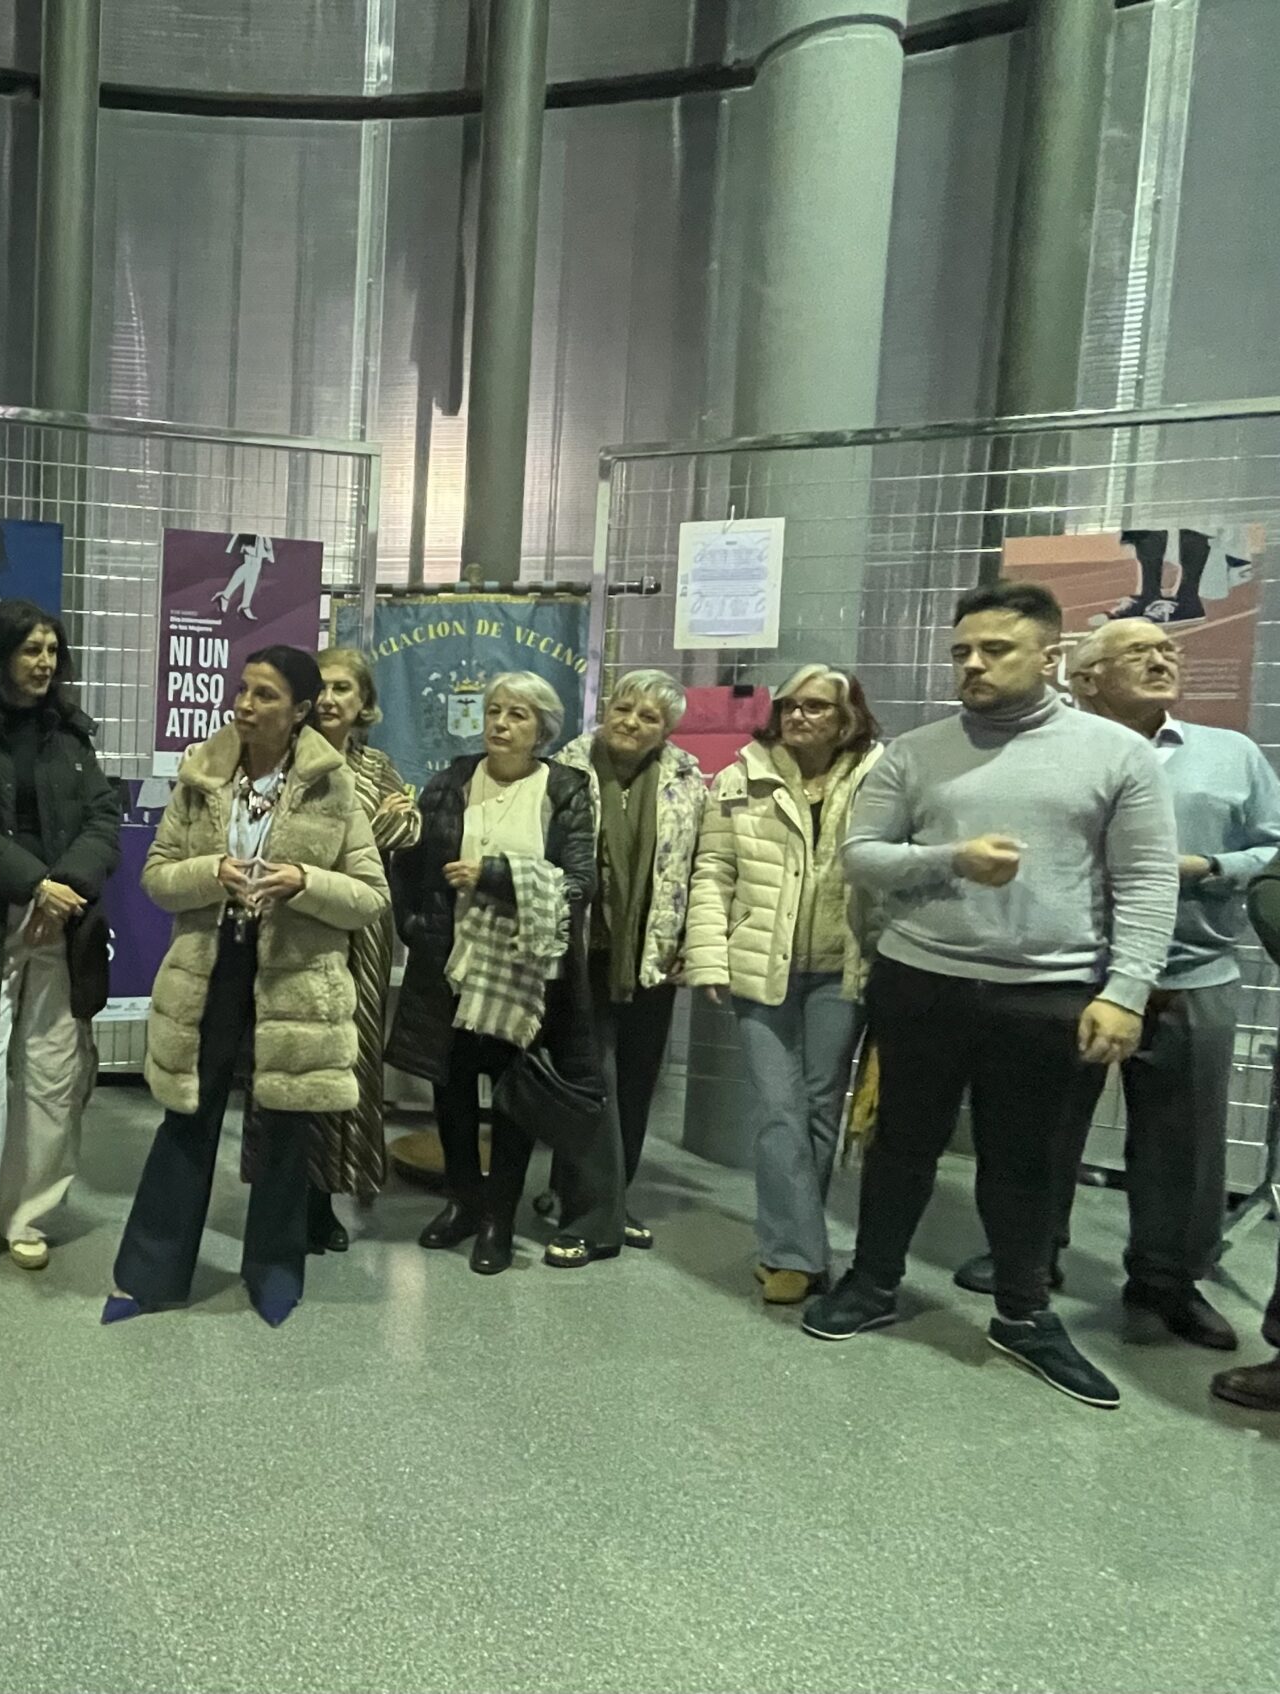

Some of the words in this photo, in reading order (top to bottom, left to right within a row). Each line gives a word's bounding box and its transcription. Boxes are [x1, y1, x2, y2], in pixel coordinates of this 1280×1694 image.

[169, 635, 193, 667] NI
[198, 637, 229, 669] UN
[476, 619, 504, 638] DE
[515, 626, 588, 673] VECINO
[167, 671, 225, 704] PASO
